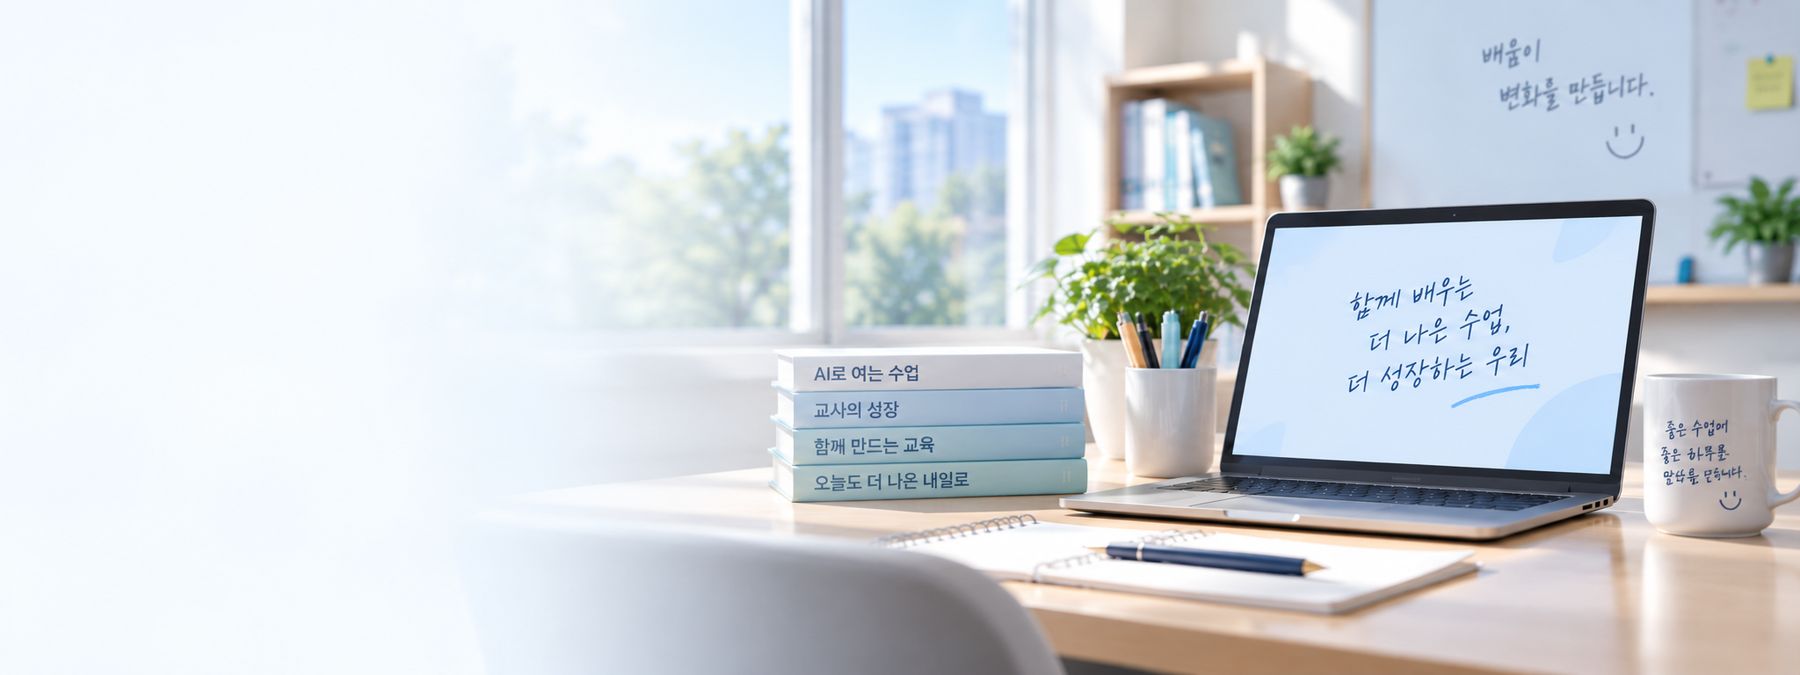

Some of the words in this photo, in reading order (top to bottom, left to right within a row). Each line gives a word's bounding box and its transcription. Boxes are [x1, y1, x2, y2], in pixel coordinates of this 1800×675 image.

[1483, 39, 1540, 68] 배움이
[1500, 78, 1559, 111] 변화를
[1569, 73, 1653, 104] 만듭니다.
[1413, 276, 1473, 306] 배우는
[1370, 330, 1390, 350] 더
[1405, 318, 1447, 344] 나은
[1460, 304, 1509, 340] 수업,
[814, 367, 846, 381] AI로
[852, 365, 883, 382] 여는
[888, 365, 919, 382] 수업
[1349, 371, 1368, 392] 더
[1381, 354, 1472, 391] 성장하는
[1487, 344, 1528, 376] 우리
[814, 402, 861, 418] 교사의
[868, 401, 899, 418] 성장
[1666, 421, 1687, 439] 좋은
[852, 438, 898, 455] 만드는
[903, 436, 934, 453] 교육
[1661, 447, 1681, 464] 좋은
[815, 475, 862, 491] 오늘도
[868, 474, 881, 490] 더
[888, 473, 919, 489] 나온
[923, 472, 969, 488] 내일로
